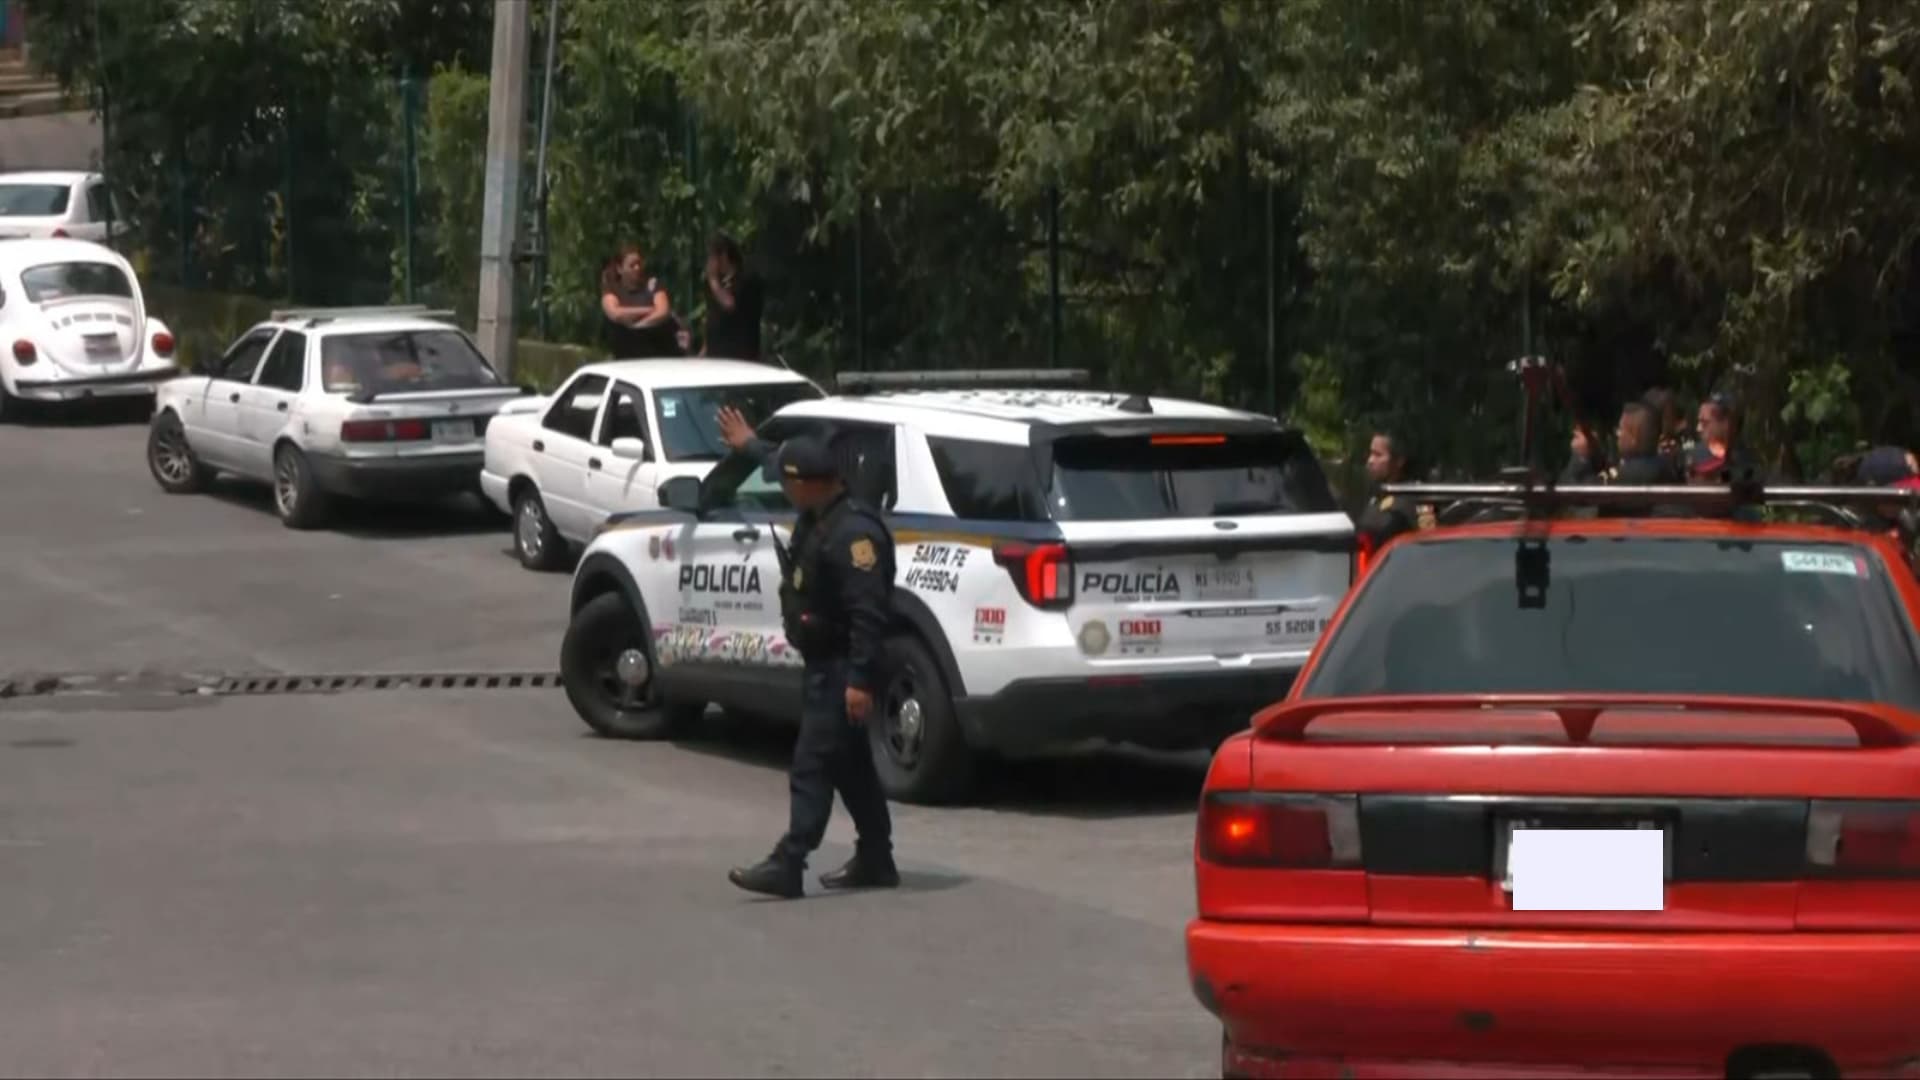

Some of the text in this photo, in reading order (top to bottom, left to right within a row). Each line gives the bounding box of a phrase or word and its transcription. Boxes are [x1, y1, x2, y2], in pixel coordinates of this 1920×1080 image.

[912, 544, 971, 568] SANTA FE
[678, 554, 762, 594] POLICÍA
[1082, 566, 1181, 594] POLICÍA
